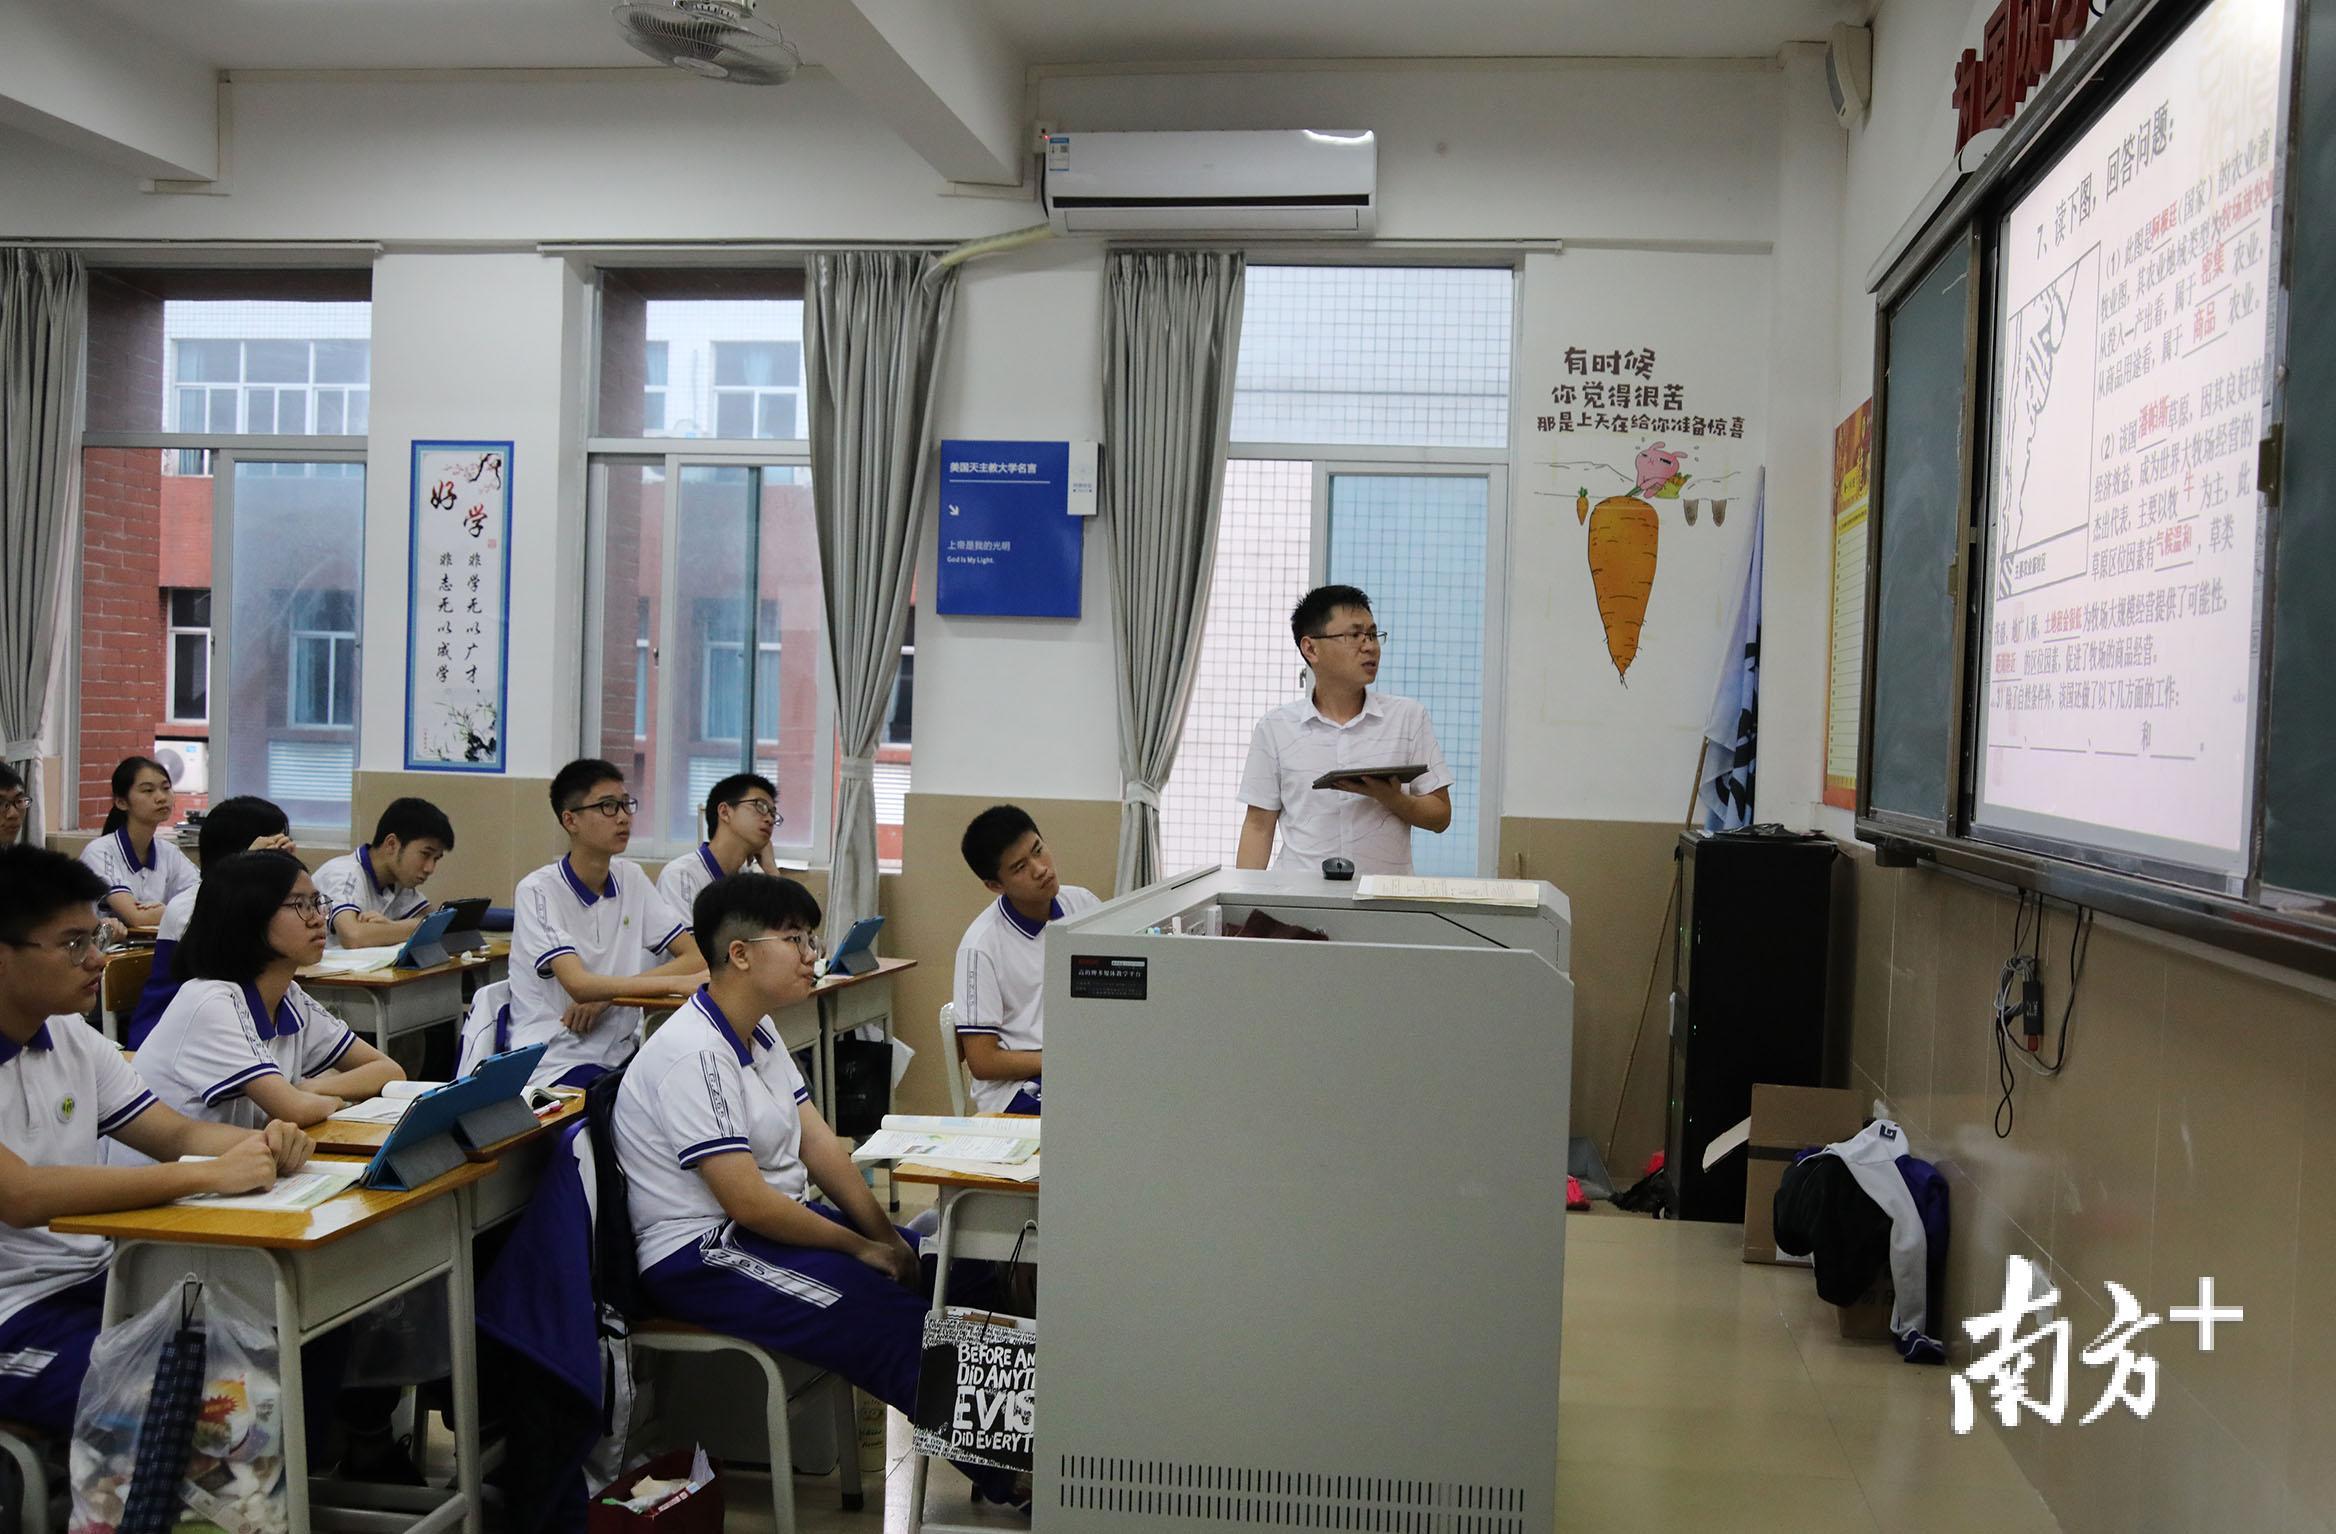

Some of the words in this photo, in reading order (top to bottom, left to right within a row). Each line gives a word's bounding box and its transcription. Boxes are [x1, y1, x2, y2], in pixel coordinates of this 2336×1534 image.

[1564, 346, 1656, 380] 有时候
[1551, 381, 1684, 411] 你觉得很苦
[1537, 411, 1745, 439] 那是上天在给你准备惊喜
[949, 462, 1037, 474] 美国天主教大学名言
[947, 540, 1011, 552] 上帝是我的光明
[947, 556, 960, 564] God
[967, 556, 976, 565] My
[957, 1343, 1012, 1368] BEFORE
